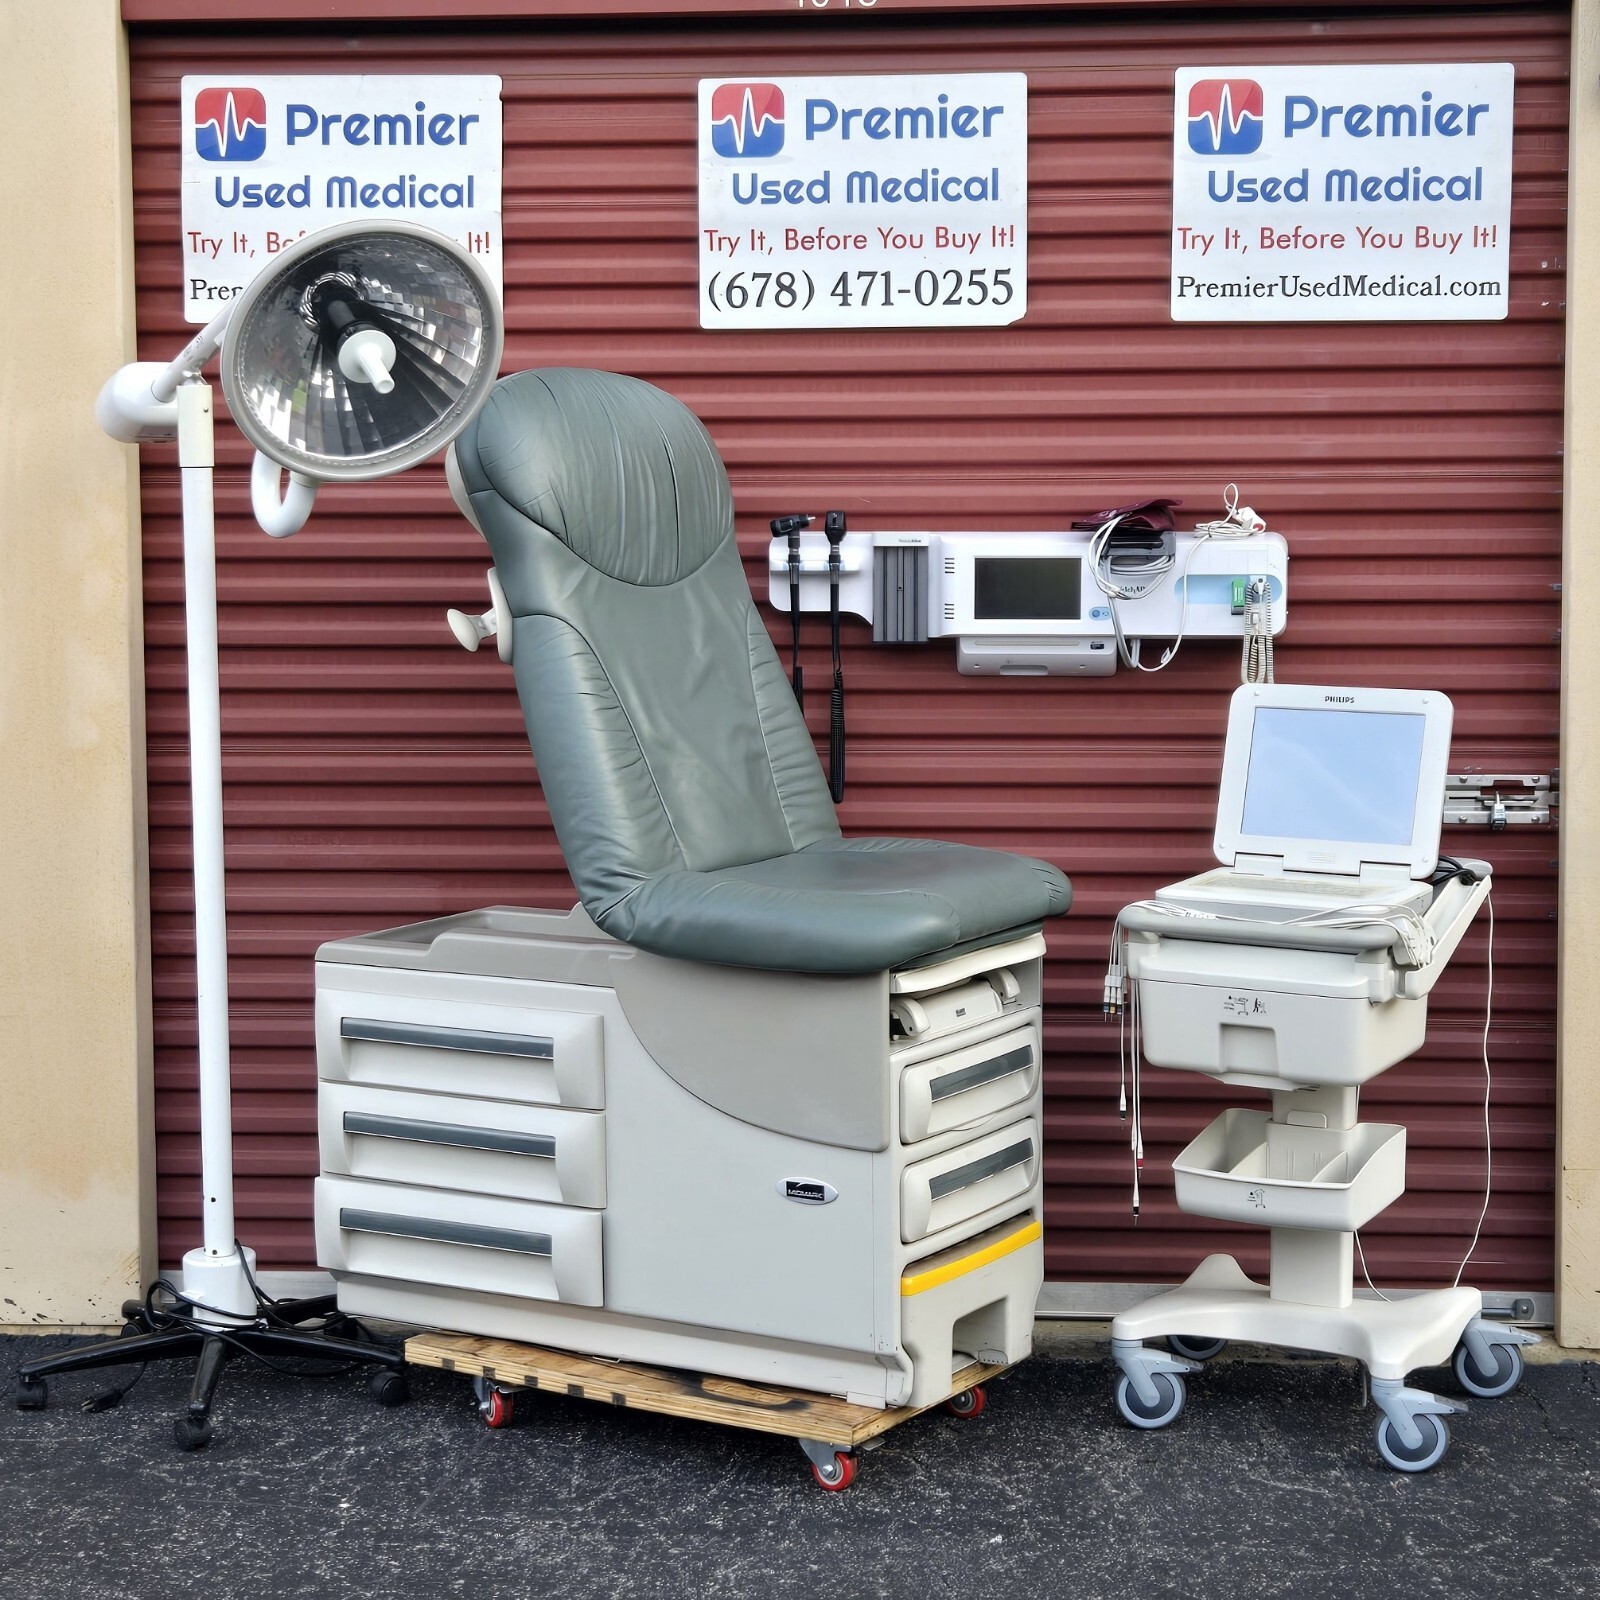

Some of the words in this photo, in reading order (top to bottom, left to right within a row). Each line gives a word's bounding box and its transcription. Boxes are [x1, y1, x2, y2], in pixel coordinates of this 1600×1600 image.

[287, 101, 479, 146] Premier
[805, 93, 1004, 141] Premier
[1284, 91, 1489, 138] Premier
[215, 174, 311, 208] Used
[326, 174, 474, 208] Medical
[732, 170, 830, 205] Used
[846, 167, 999, 204] Medical
[1207, 168, 1309, 203] Used
[1324, 166, 1482, 202] Medical
[187, 232, 223, 259] Try
[233, 231, 255, 258] It,
[468, 231, 490, 254] It!
[703, 229, 741, 258] Try
[749, 228, 773, 256] It,
[784, 227, 868, 251] Before
[877, 226, 924, 250] You
[935, 226, 982, 255] Buy
[991, 224, 1015, 249] It!
[1177, 227, 1215, 256] Try
[1224, 227, 1248, 254] It,
[1259, 225, 1346, 250] Before
[1356, 226, 1403, 249] You
[1414, 225, 1463, 255] Buy
[1473, 224, 1497, 248] It!
[708, 269, 815, 312] (678)
[830, 268, 1014, 307] 471-0255
[1177, 274, 1502, 298] PremierUsedMedical.com
[1324, 695, 1355, 704] PHILIPS
